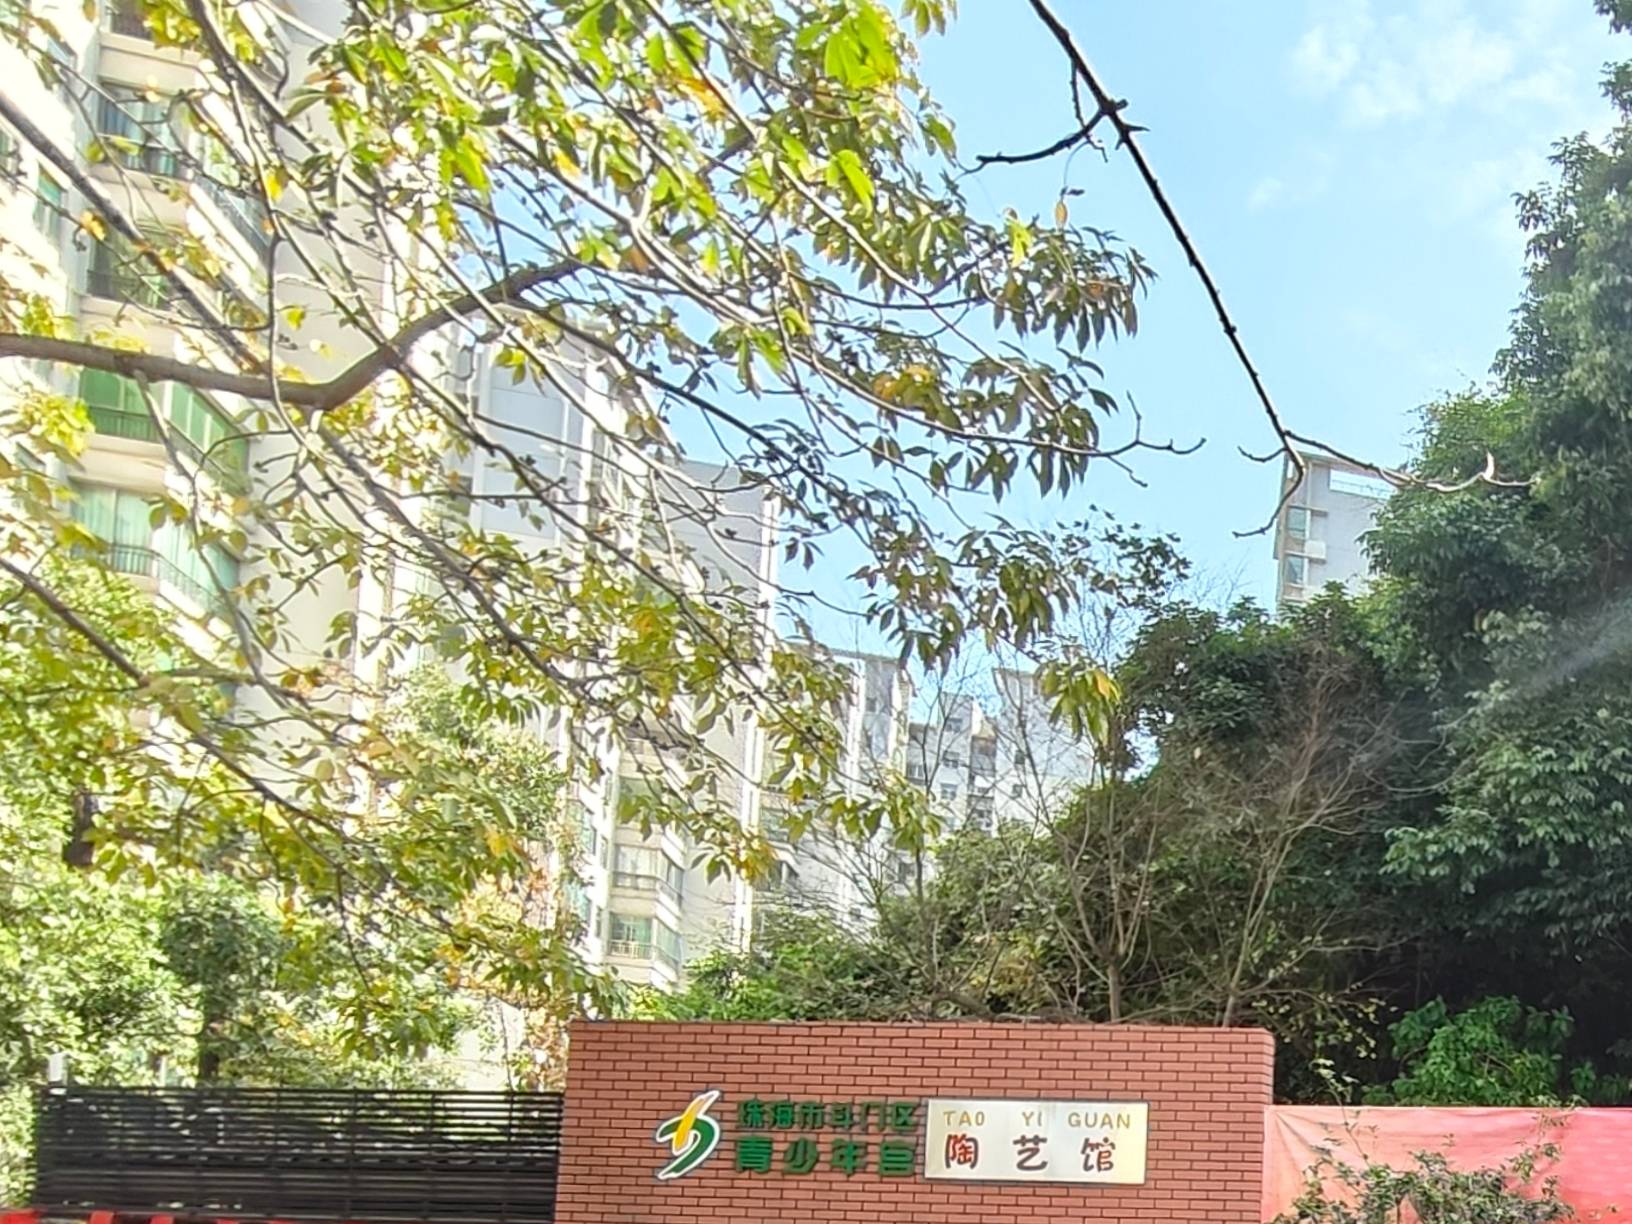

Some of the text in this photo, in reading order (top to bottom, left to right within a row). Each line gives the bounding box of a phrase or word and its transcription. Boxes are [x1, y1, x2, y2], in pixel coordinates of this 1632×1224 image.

[738, 1100, 919, 1131] 珠海市斗门区
[943, 1111, 1130, 1128] TAO YI GUAN
[736, 1136, 916, 1177] 青少年宫
[945, 1134, 1116, 1172] 陶艺馆
